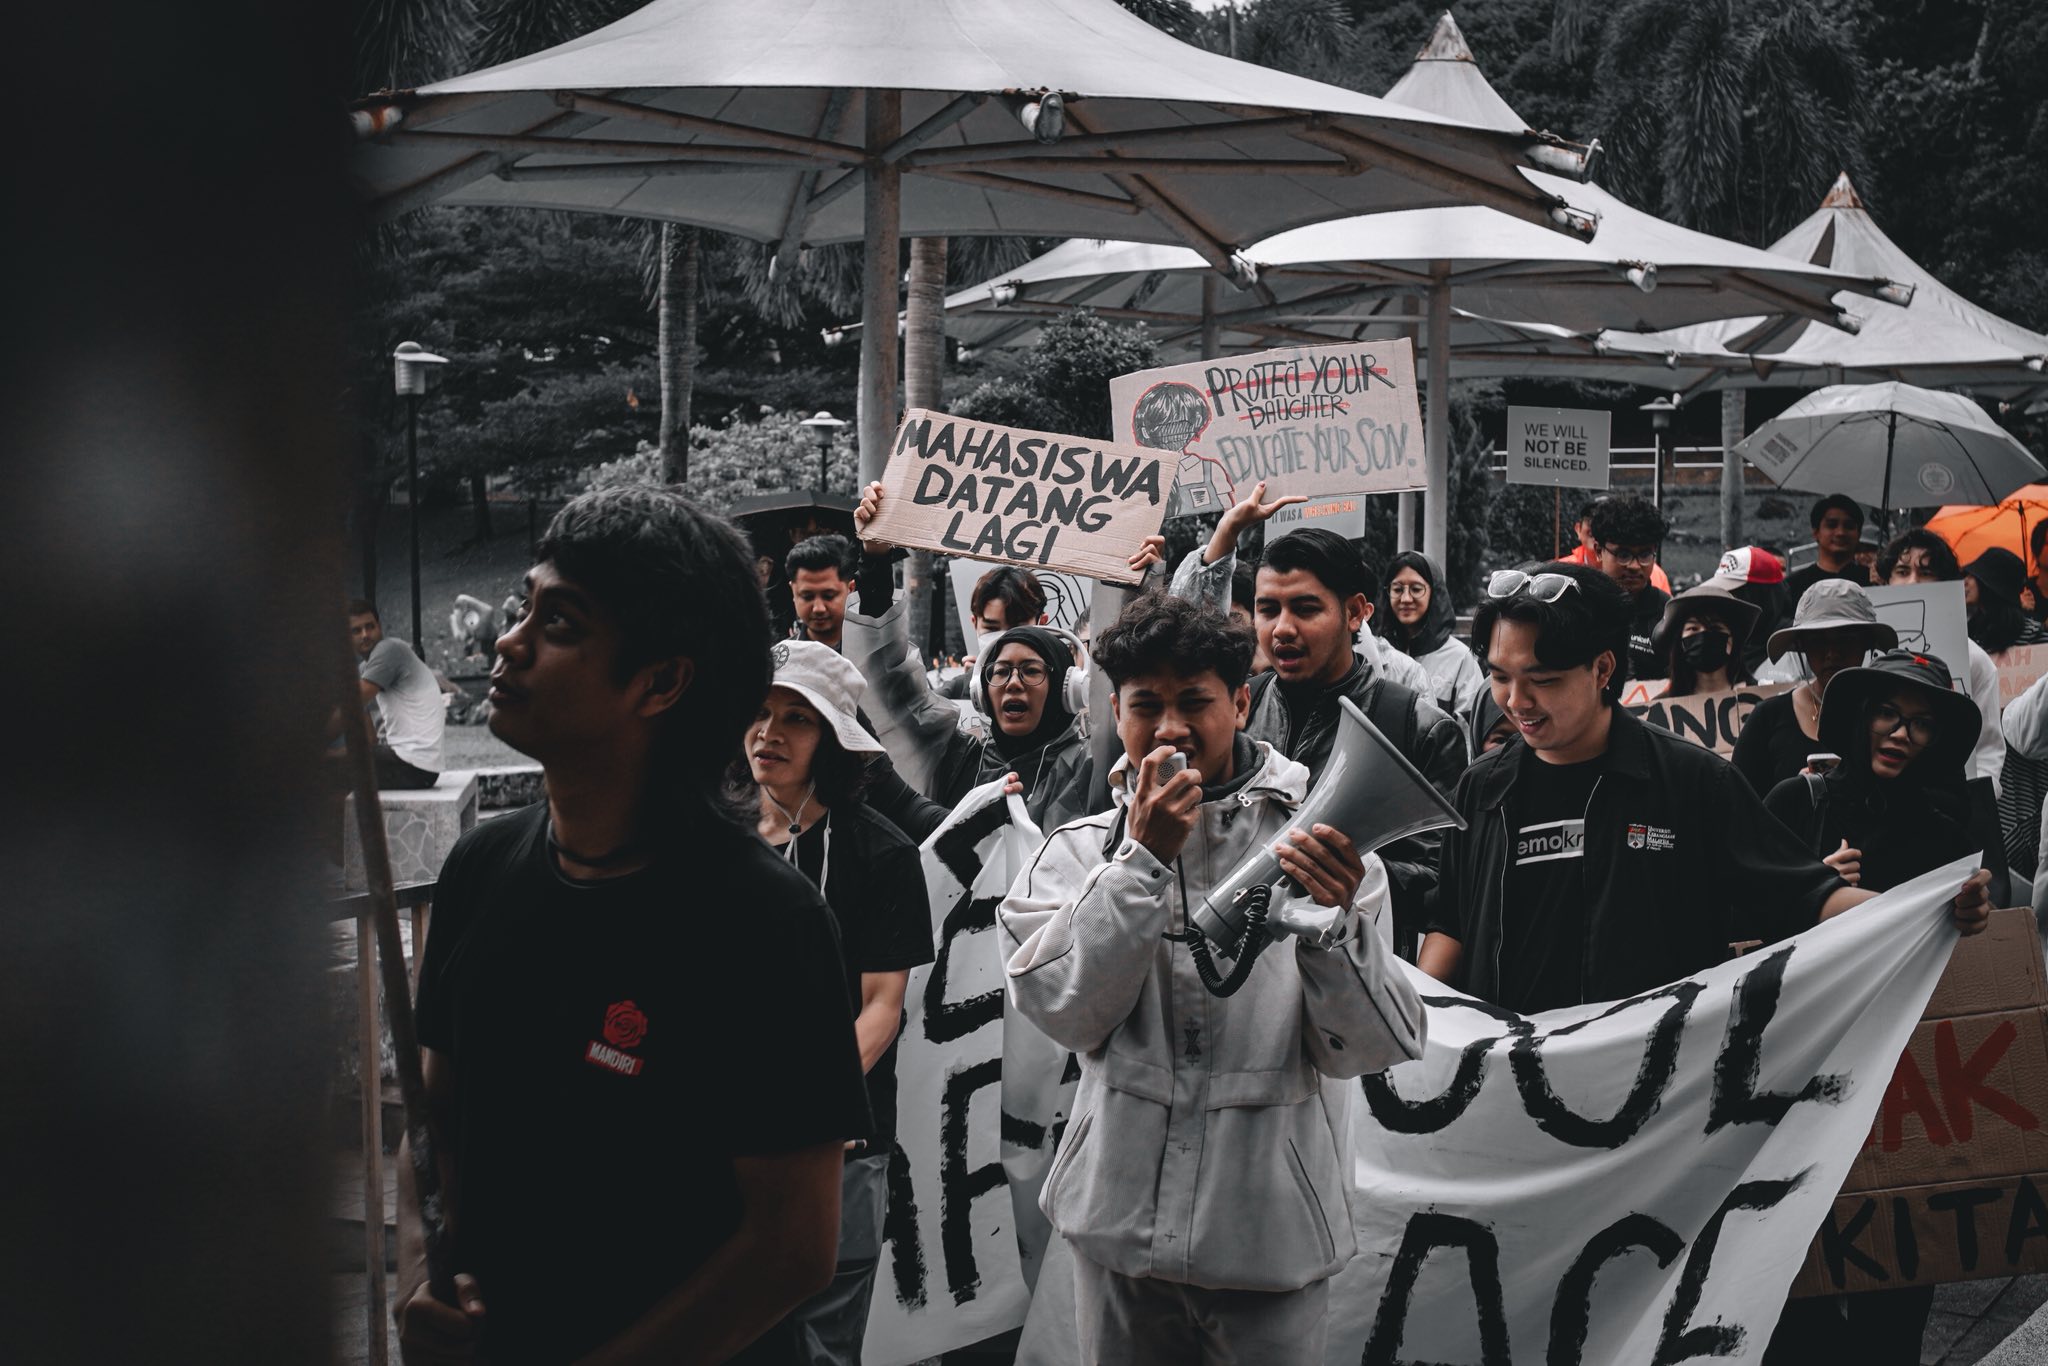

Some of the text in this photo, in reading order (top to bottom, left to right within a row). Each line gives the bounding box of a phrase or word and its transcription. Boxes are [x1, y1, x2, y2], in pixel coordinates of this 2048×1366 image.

[1205, 354, 1396, 416] PROTECT YOUR
[1248, 394, 1348, 430] DAUGHTER
[1524, 423, 1588, 439] WE WILL
[897, 419, 1160, 506] MAHASISWA
[1216, 418, 1417, 484] EDUCATE YOUR SON.
[1524, 440, 1587, 456] NOT BE
[1524, 457, 1591, 471] SILENCED.
[913, 464, 1112, 533] DATANG
[1280, 509, 1296, 523] WAS
[1297, 508, 1303, 520] A
[940, 511, 1060, 564] LAGI
[589, 1041, 636, 1075] MANDIRI
[1822, 1177, 2048, 1289] KITA
